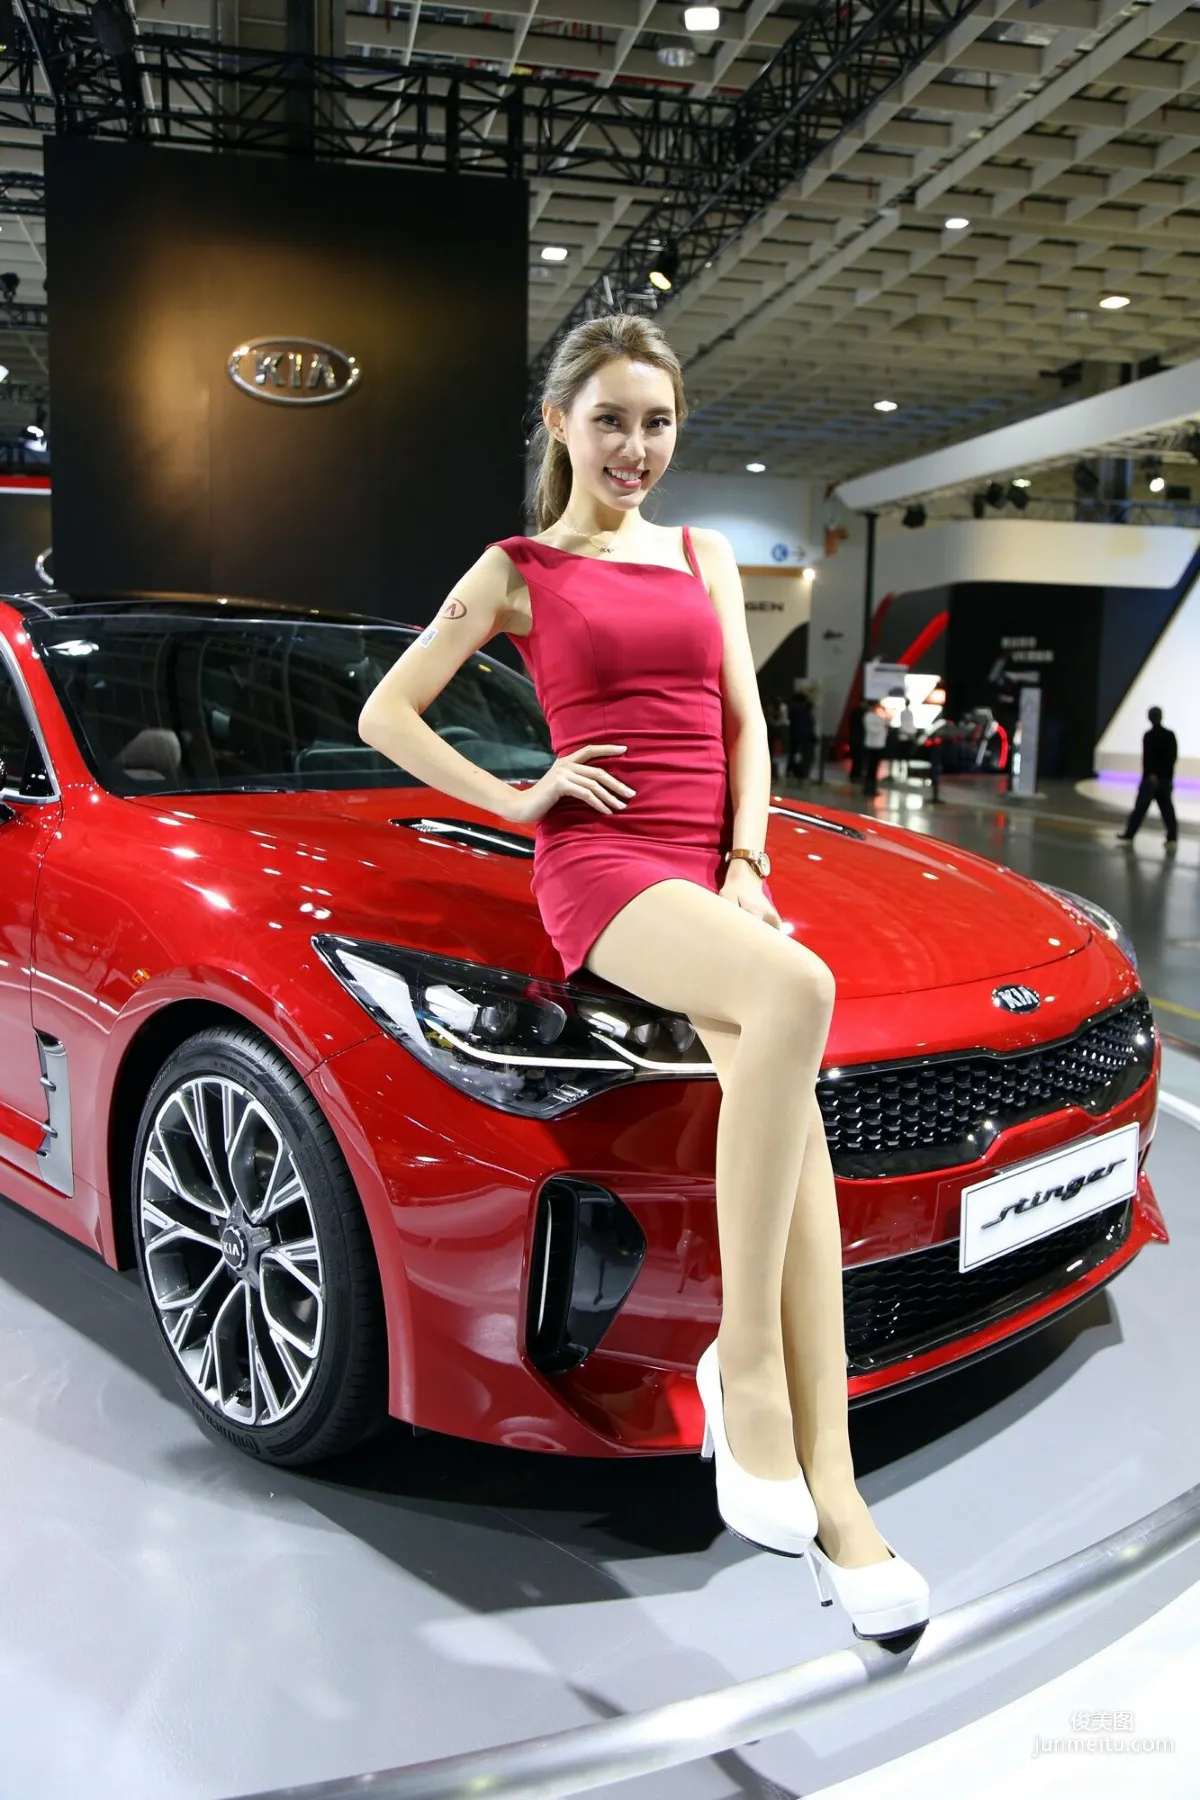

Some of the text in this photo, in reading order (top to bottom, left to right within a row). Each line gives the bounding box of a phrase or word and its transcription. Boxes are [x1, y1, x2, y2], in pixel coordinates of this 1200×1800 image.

[255, 351, 337, 388] KIA
[997, 986, 1039, 1009] KIA
[222, 1241, 240, 1257] KIA
